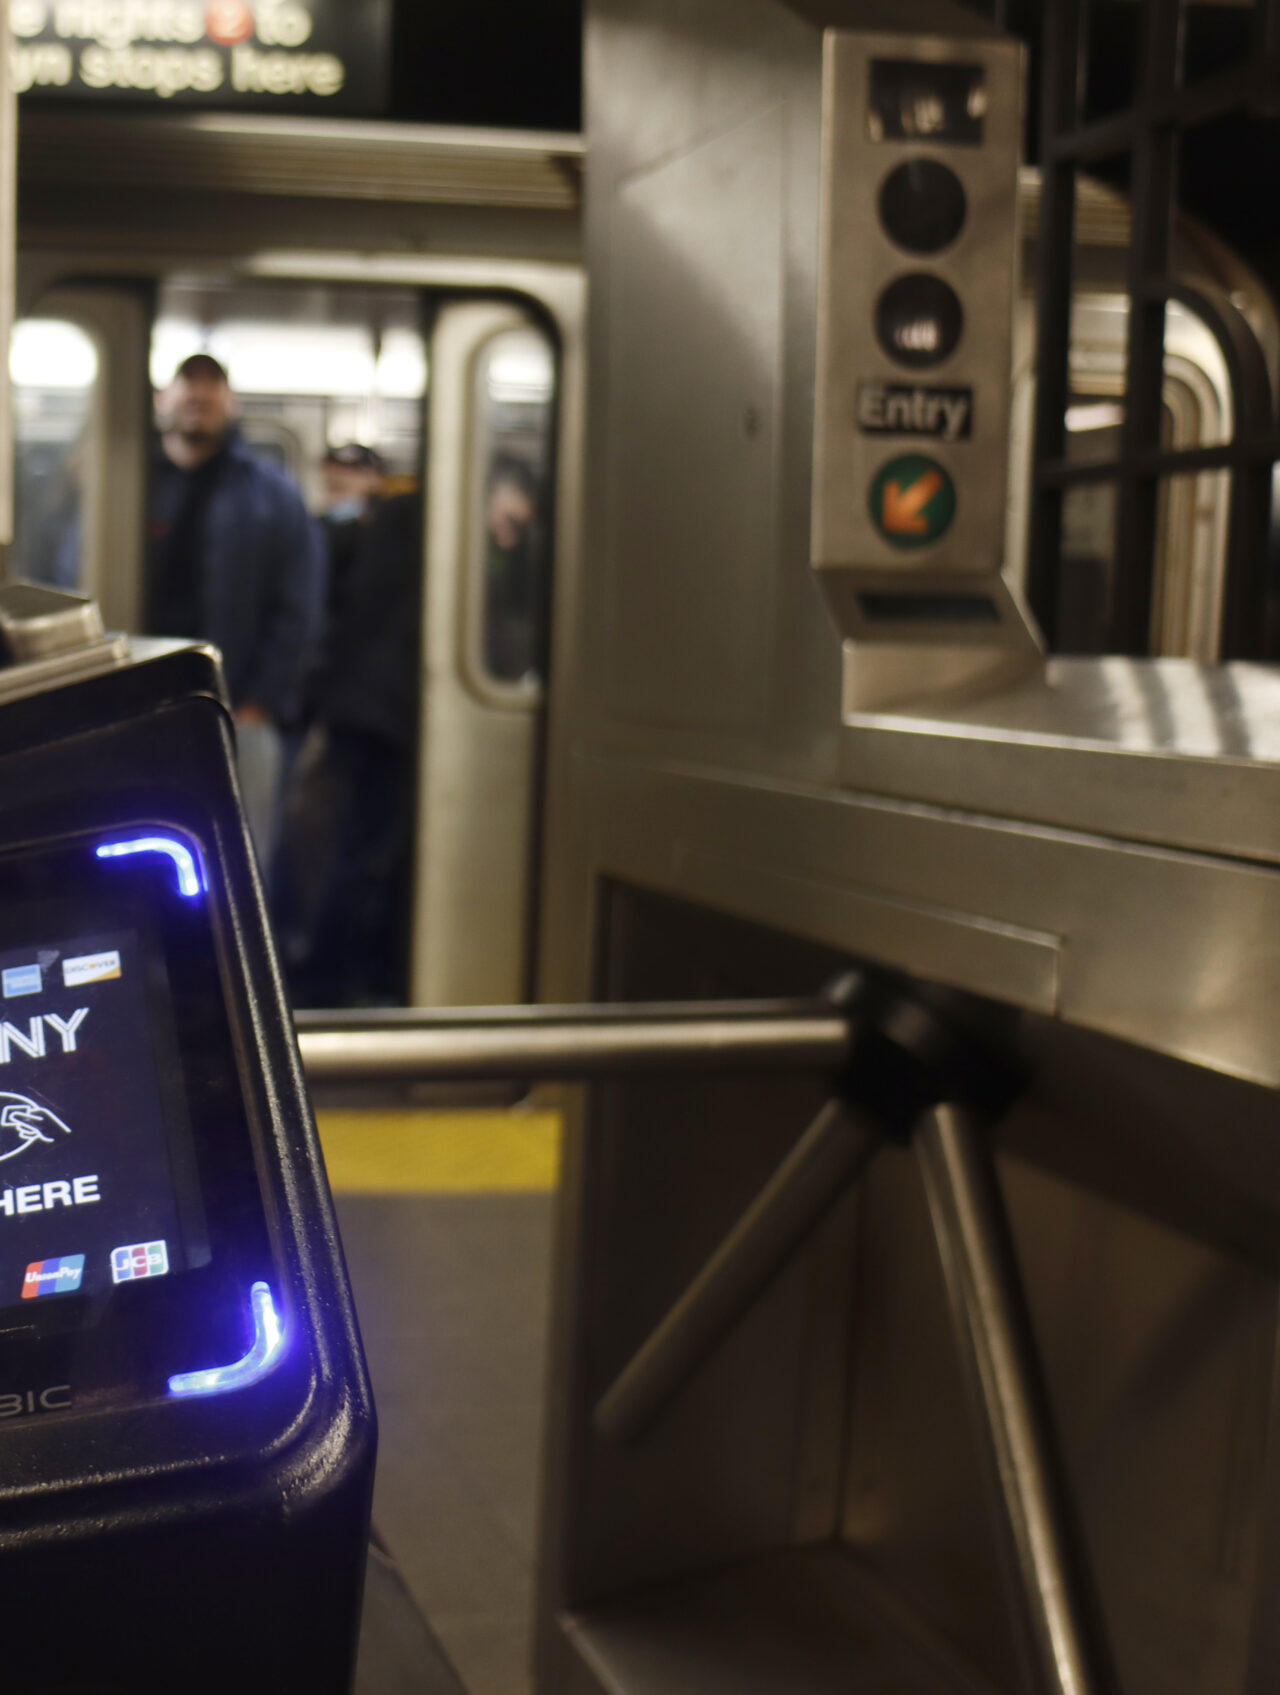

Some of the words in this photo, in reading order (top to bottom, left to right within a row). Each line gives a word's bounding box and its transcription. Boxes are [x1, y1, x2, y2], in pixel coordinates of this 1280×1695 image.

[257, 0, 312, 47] to
[80, 45, 224, 98] stops
[231, 44, 345, 96] here
[858, 384, 968, 441] Entry
[25, 1266, 82, 1283] UnionPay
[115, 1253, 163, 1271] JCB
